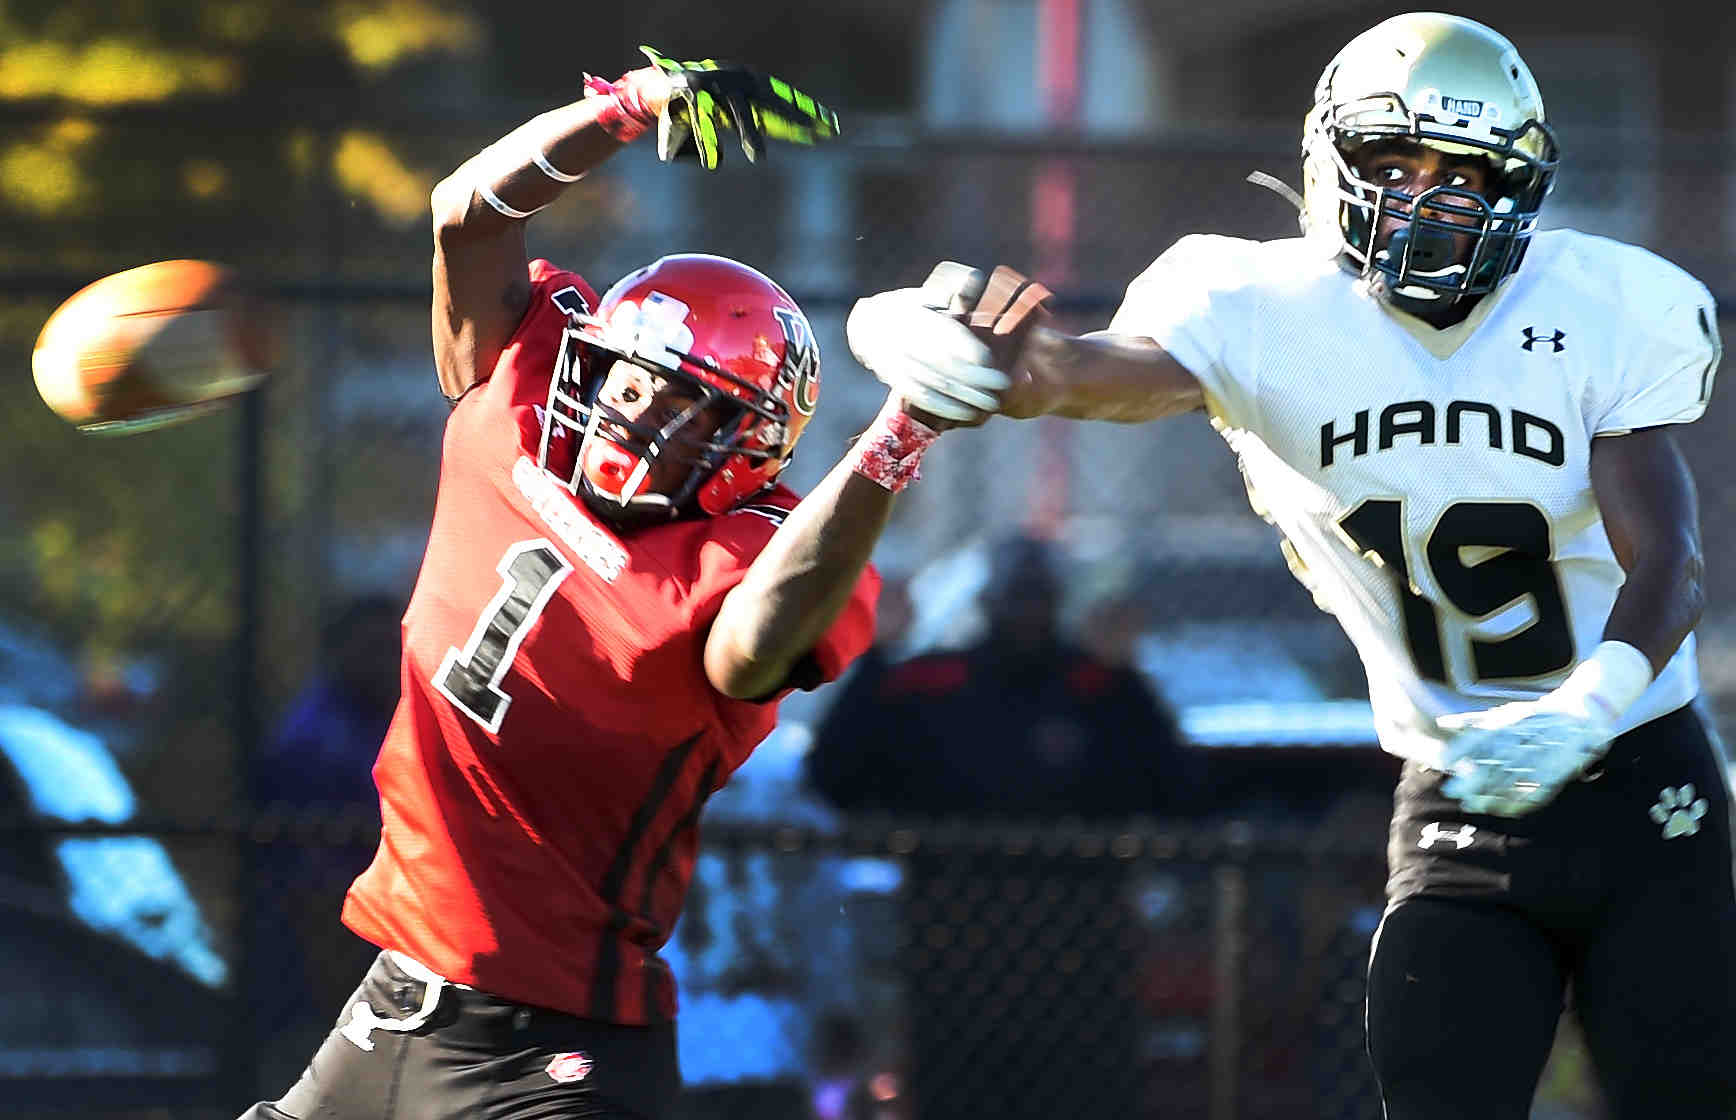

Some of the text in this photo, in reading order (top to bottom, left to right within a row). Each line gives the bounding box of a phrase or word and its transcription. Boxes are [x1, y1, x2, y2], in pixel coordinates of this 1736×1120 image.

[1320, 399, 1566, 468] HAND
[431, 538, 574, 734] 1
[1335, 497, 1577, 688] 19
